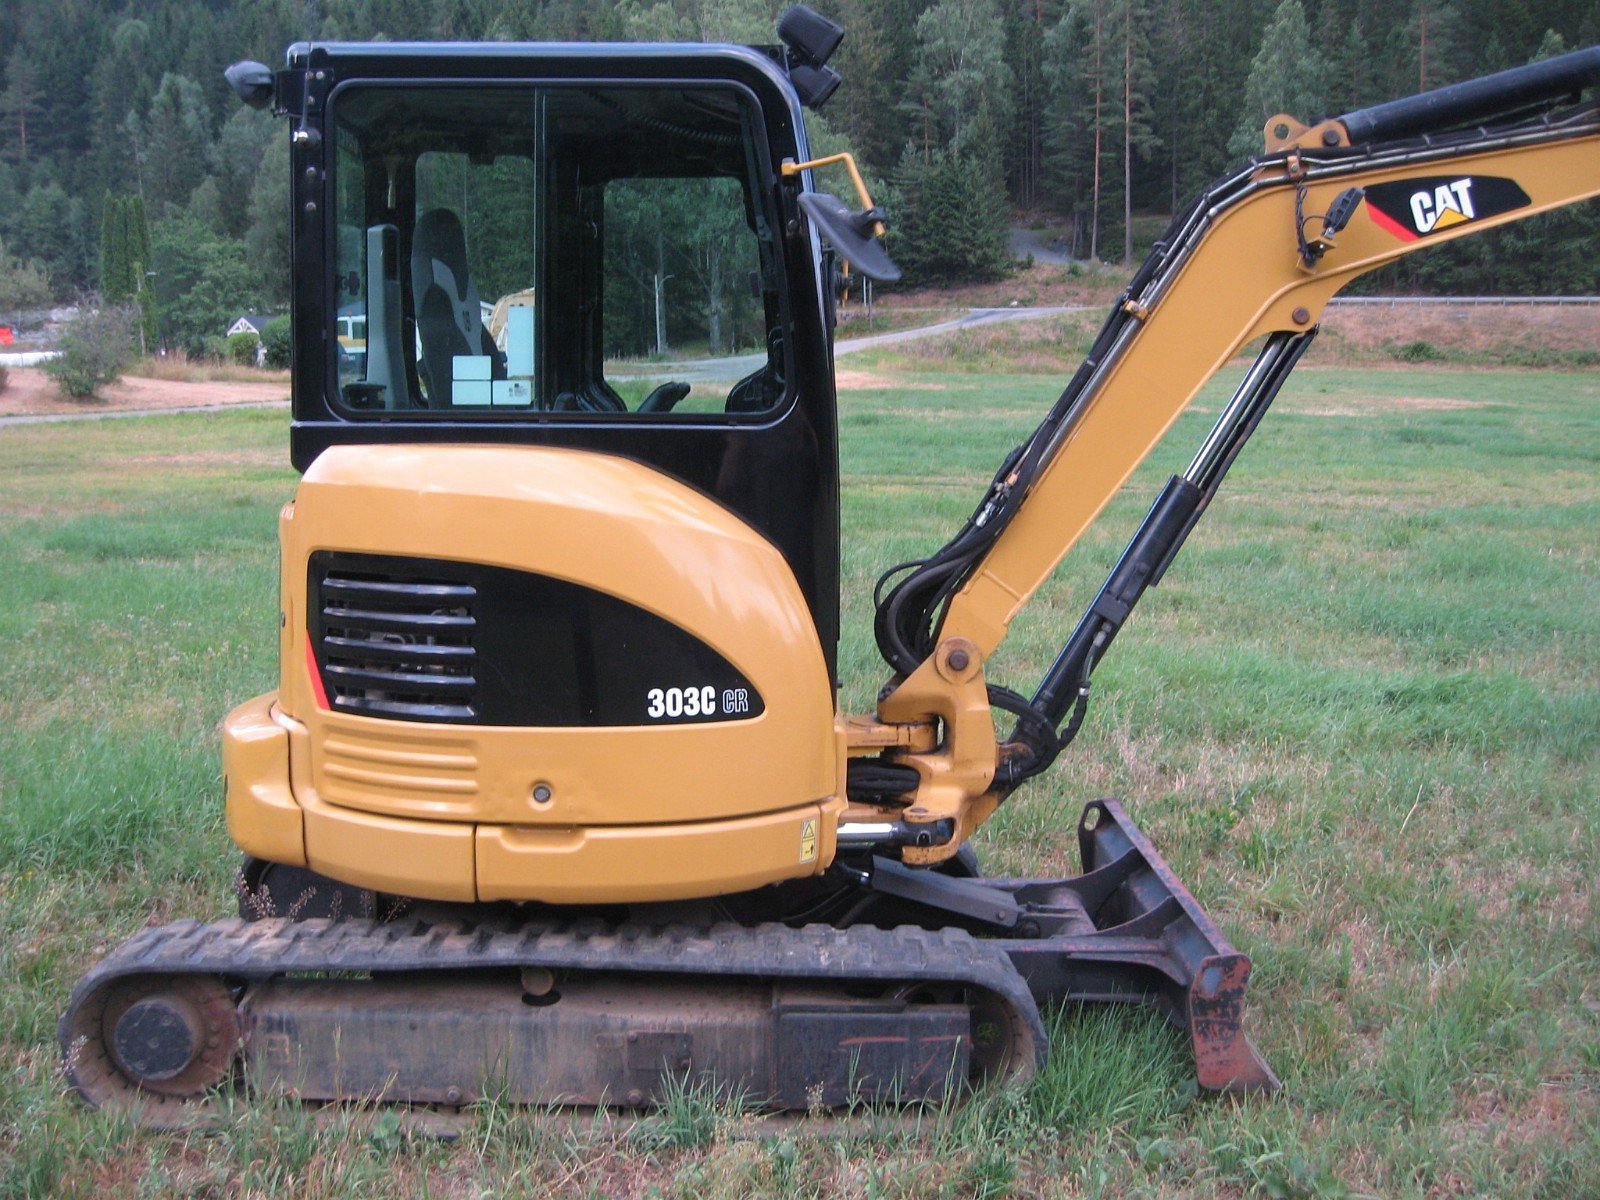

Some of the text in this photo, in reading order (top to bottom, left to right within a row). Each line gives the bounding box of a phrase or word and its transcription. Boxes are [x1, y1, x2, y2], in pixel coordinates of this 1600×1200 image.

[1410, 178, 1474, 232] CAT
[647, 686, 749, 718] 303C CR
